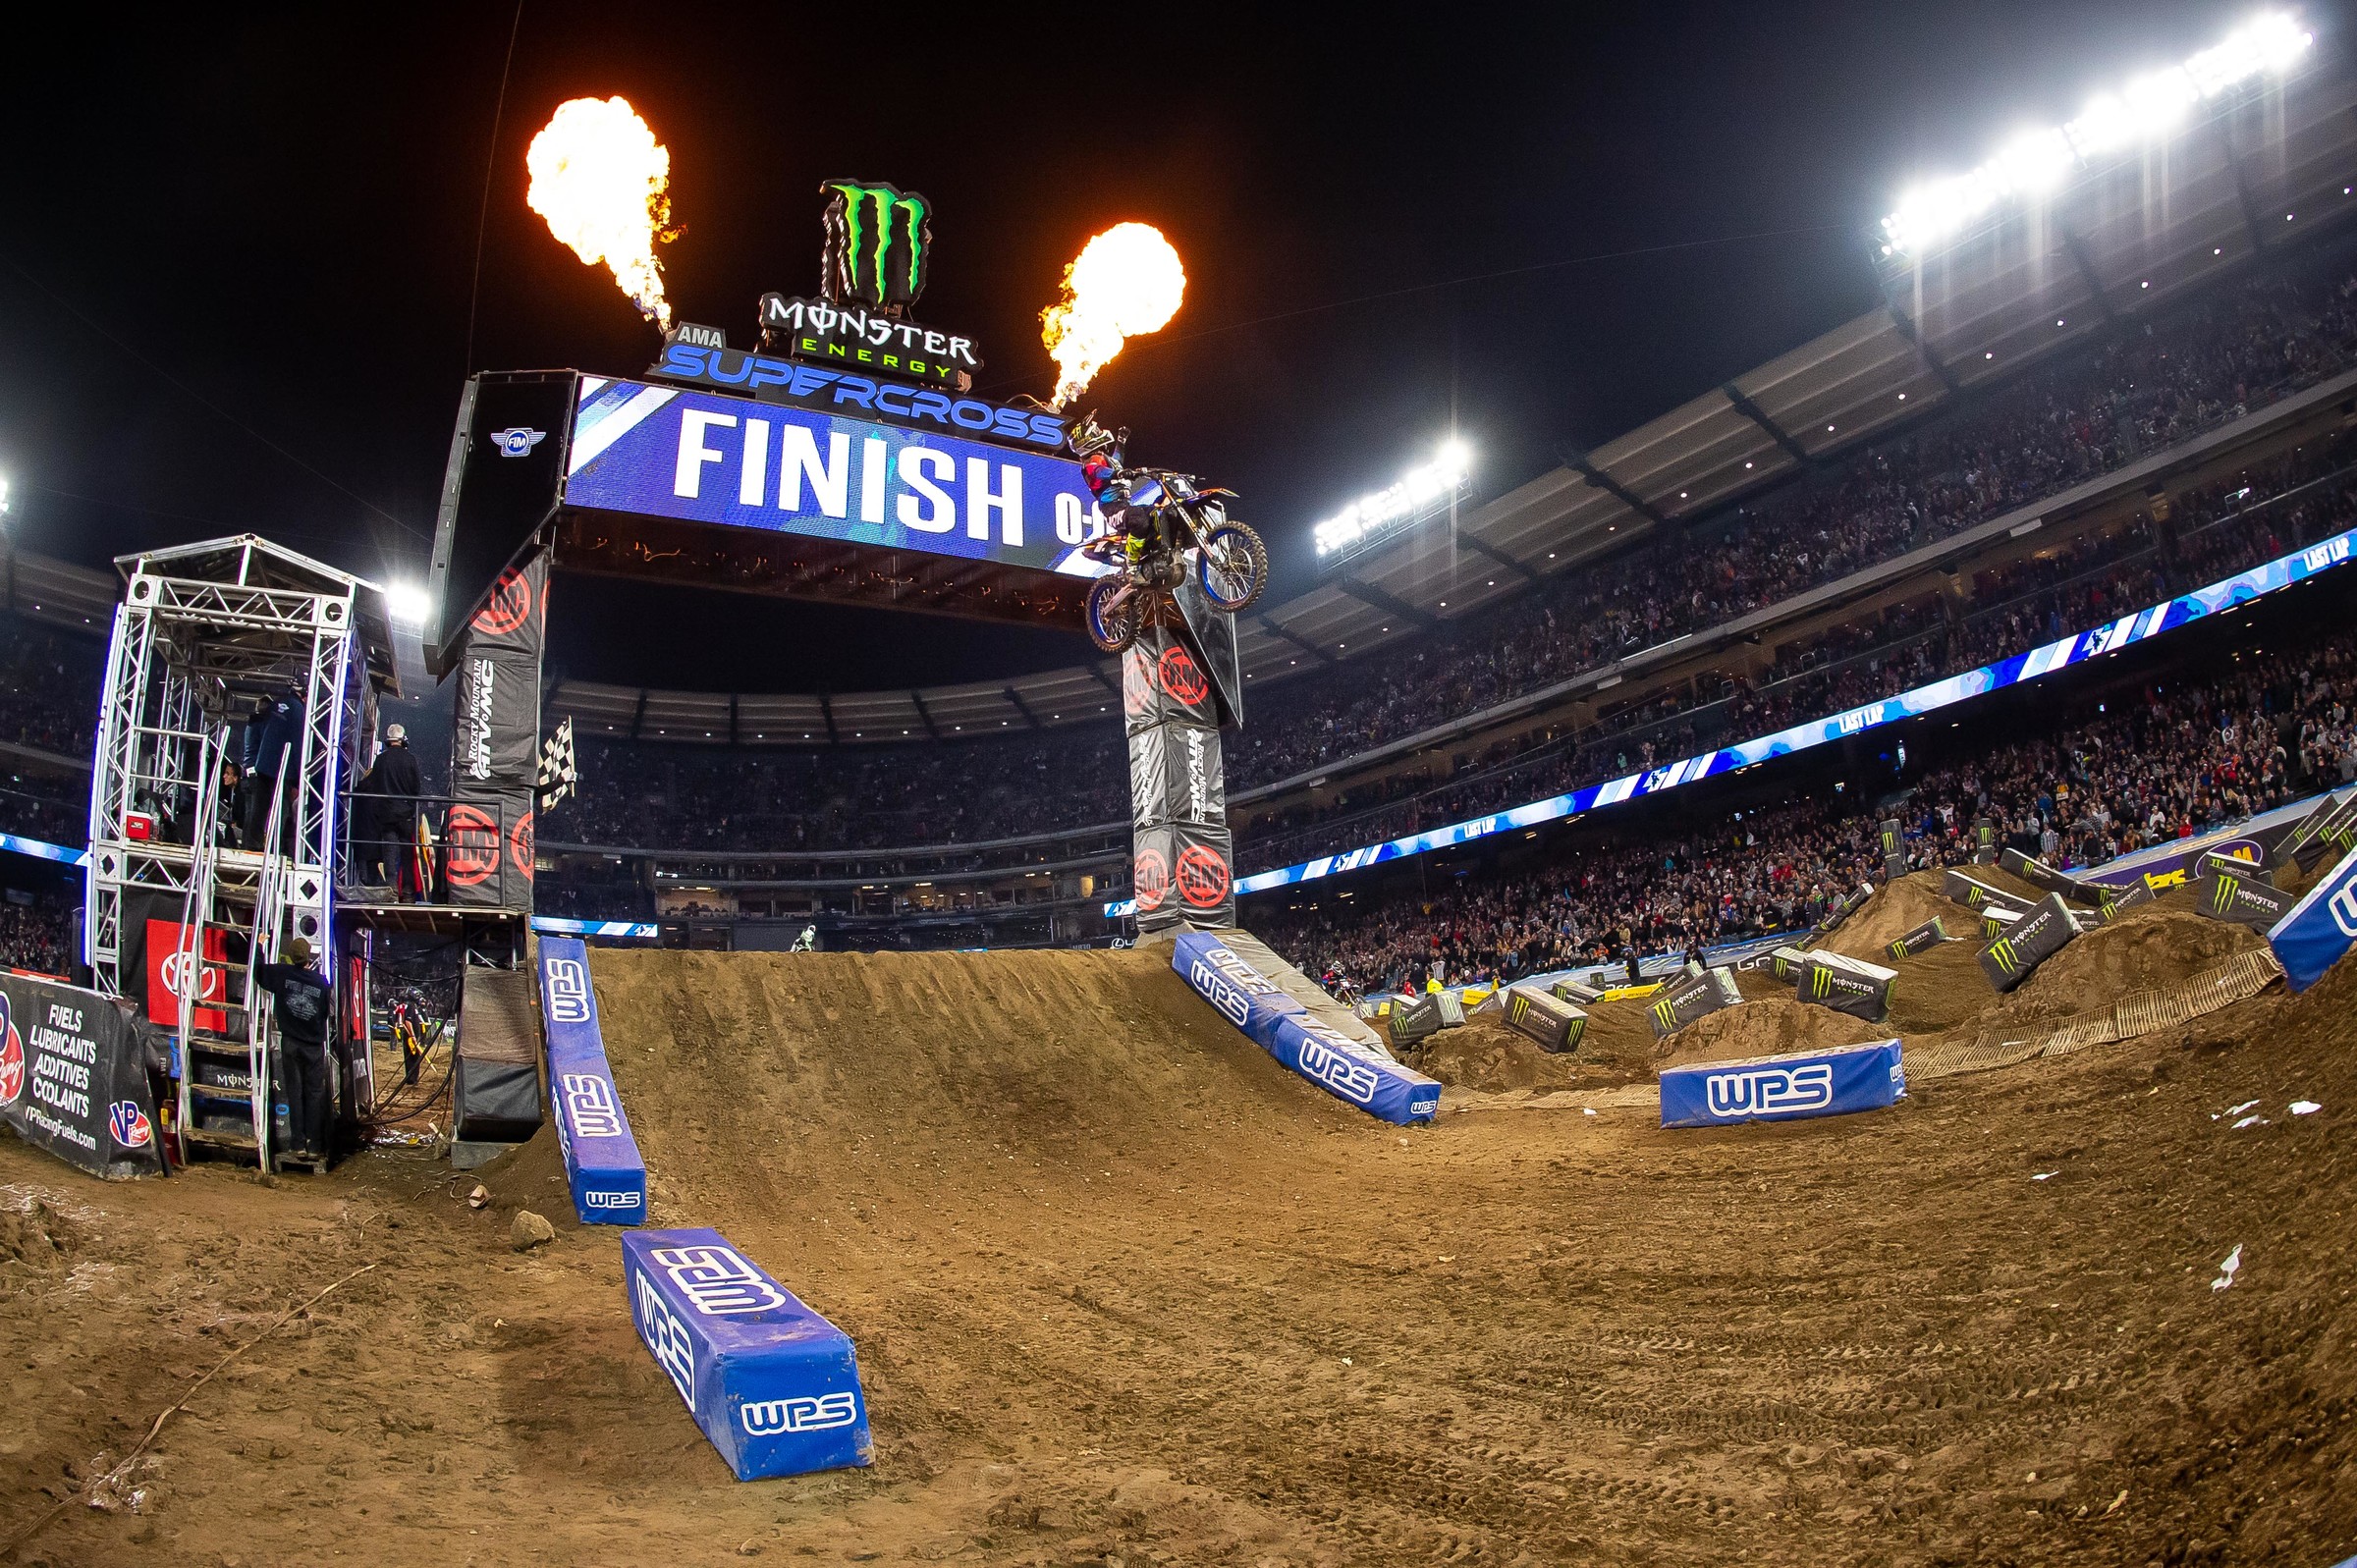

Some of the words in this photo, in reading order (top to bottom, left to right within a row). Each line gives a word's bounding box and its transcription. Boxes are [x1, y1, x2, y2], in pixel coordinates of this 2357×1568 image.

[677, 325, 724, 349] AMA
[769, 297, 977, 366] MONSTER
[801, 338, 952, 378] ENERGY
[656, 344, 1069, 447] SUPERCROSS
[509, 437, 526, 449] FIM
[673, 407, 1024, 548] FINISH
[2303, 545, 2330, 571] LAST
[2329, 537, 2349, 562] LAP
[470, 659, 482, 722] MOUNTAIN
[1838, 711, 1863, 733] LAST
[1864, 705, 1885, 727] LAP
[468, 722, 478, 760] ROCKY
[1463, 822, 1481, 838] LAST
[1481, 817, 1496, 834] LAP
[2114, 887, 2142, 908] MONSTER
[2236, 889, 2278, 911] MONSTER
[1904, 930, 1930, 946] MONSTER
[2011, 910, 2053, 946] MONSTER
[547, 958, 590, 1023] WPS
[1190, 959, 1250, 1027] WPS
[1672, 983, 1709, 1007] MONSTER
[1833, 977, 1874, 995] MONSTER
[49, 1004, 83, 1032] FUELS
[1406, 1004, 1432, 1023] MONSTER
[1528, 1007, 1558, 1028] MONSTER
[29, 1025, 96, 1064] LUBRICANTS
[33, 1053, 90, 1090] ADDITIVES
[1298, 1037, 1379, 1104] WPS
[32, 1077, 90, 1118] COOLANTS
[563, 1074, 623, 1137] WPS
[1410, 1100, 1438, 1114] WPS
[1706, 1063, 1833, 1116] WPS
[110, 1101, 138, 1146] VP
[585, 1191, 640, 1209] WPS
[651, 1245, 788, 1316] WPS
[636, 1267, 696, 1414] WPS
[740, 1391, 857, 1437] WPS
